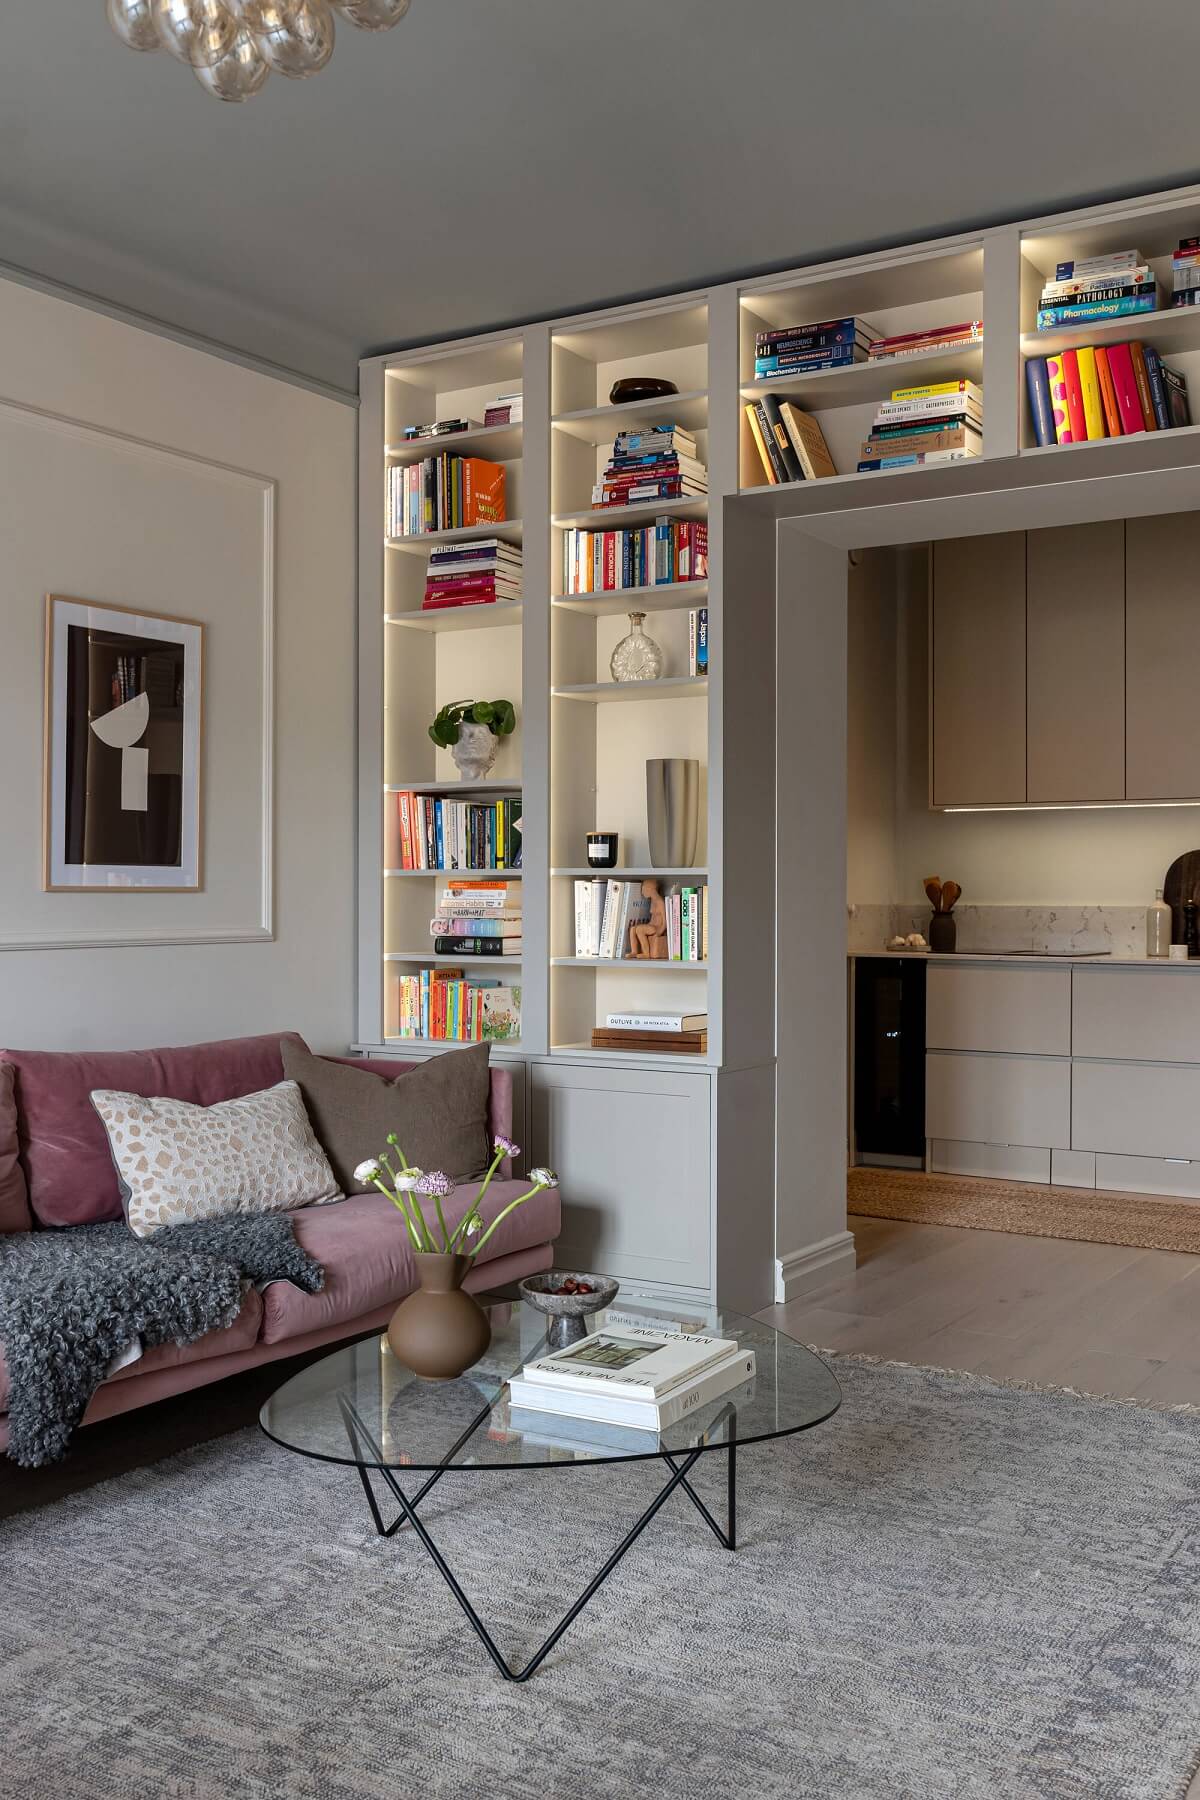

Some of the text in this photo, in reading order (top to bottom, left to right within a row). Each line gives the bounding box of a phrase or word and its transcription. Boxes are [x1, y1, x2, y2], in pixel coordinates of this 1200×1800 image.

[1076, 287, 1124, 304] PATHOLOGY
[1063, 302, 1119, 319] Pharmacology
[776, 337, 813, 349] NEUROSCIENCE
[766, 366, 801, 377] Biochemistry
[699, 622, 708, 646] Japan
[626, 1328, 713, 1345] MAGAZINE
[536, 1363, 652, 1386] THE NEW ERA
